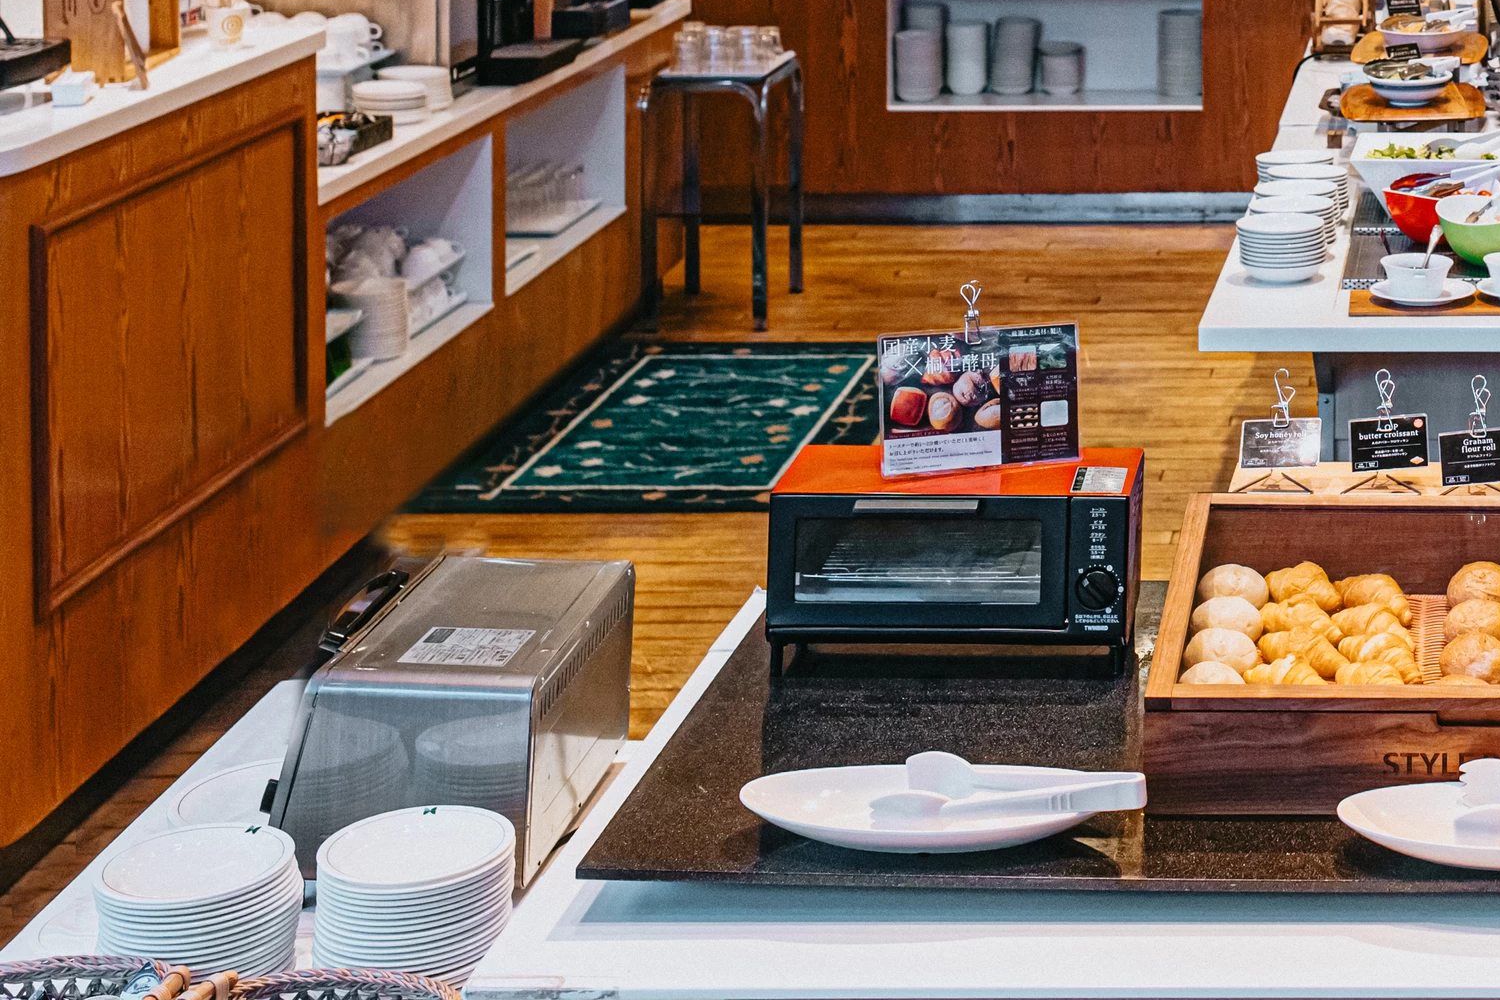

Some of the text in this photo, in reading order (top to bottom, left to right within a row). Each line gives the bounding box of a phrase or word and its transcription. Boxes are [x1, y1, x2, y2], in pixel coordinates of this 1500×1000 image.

[883, 335, 957, 358] 国産小麦
[1255, 432, 1269, 440] Soy
[1269, 431, 1293, 440] honey
[1358, 429, 1419, 441] butter croissant
[1463, 438, 1494, 446] Graham
[1461, 445, 1481, 453] flour
